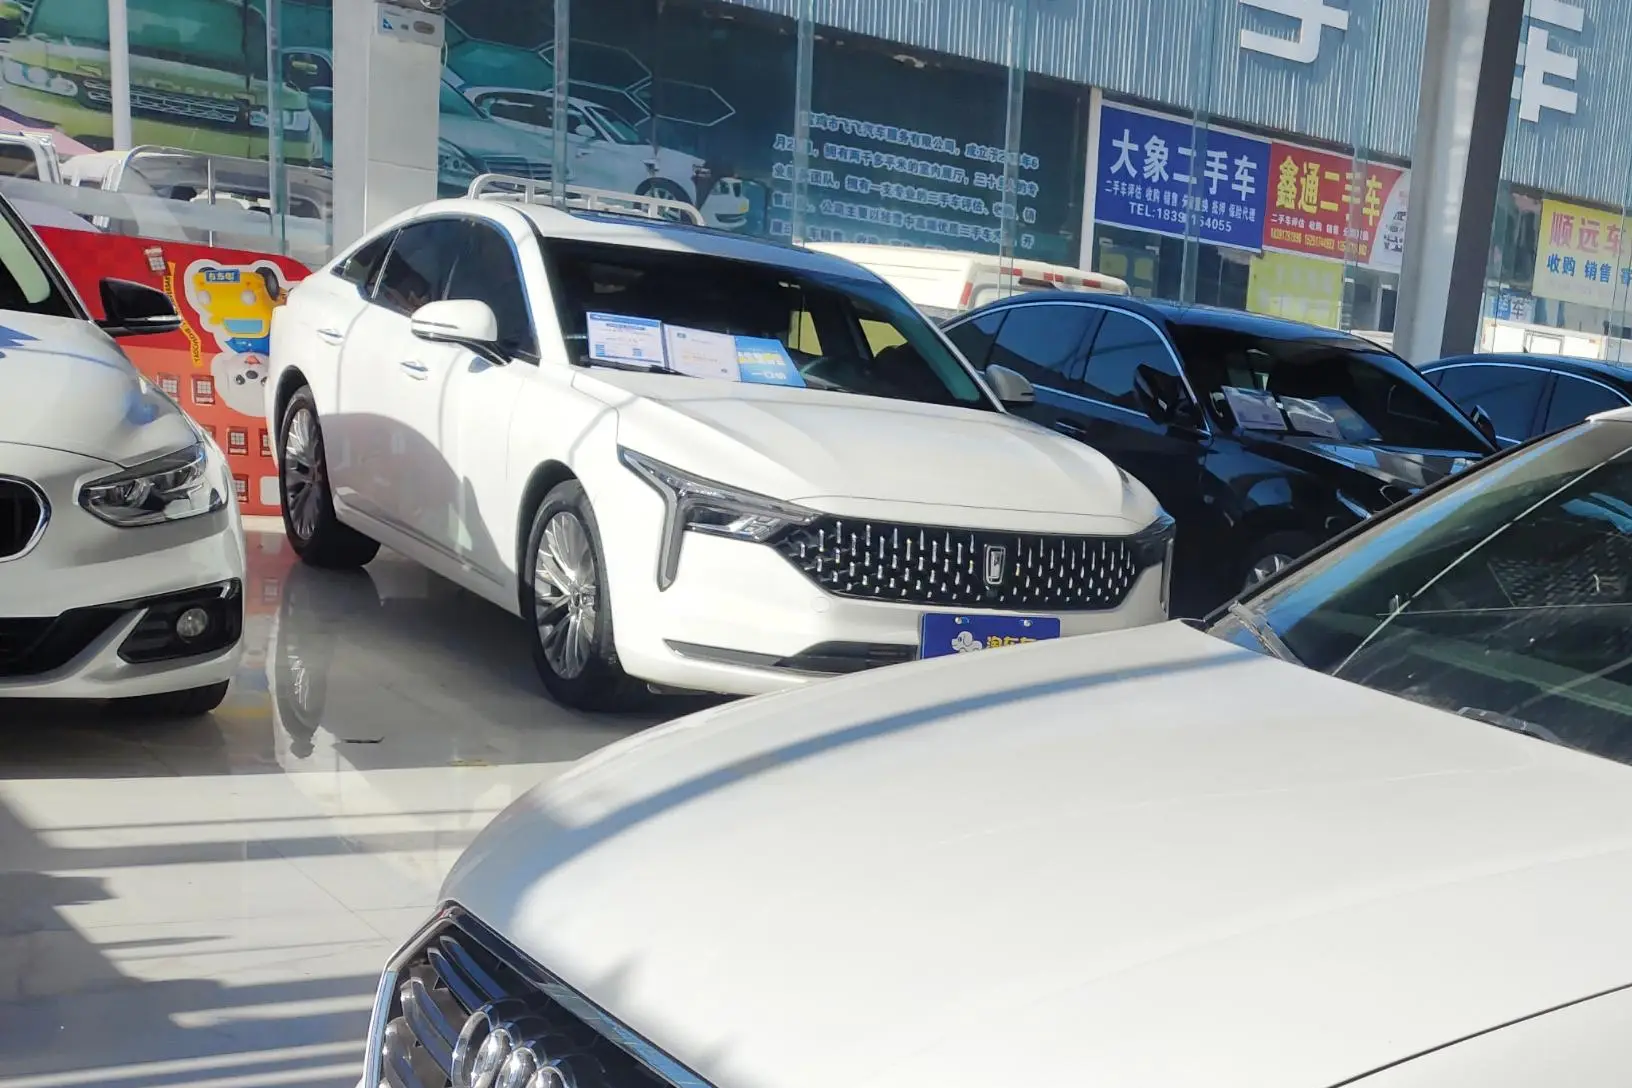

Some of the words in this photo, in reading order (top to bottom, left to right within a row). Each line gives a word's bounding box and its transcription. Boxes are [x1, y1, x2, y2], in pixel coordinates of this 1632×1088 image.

[1109, 128, 1257, 201] 大象二手车
[1275, 155, 1383, 226] 鑫通二手车
[1546, 253, 1576, 277] 收购
[1584, 260, 1612, 283] 销售
